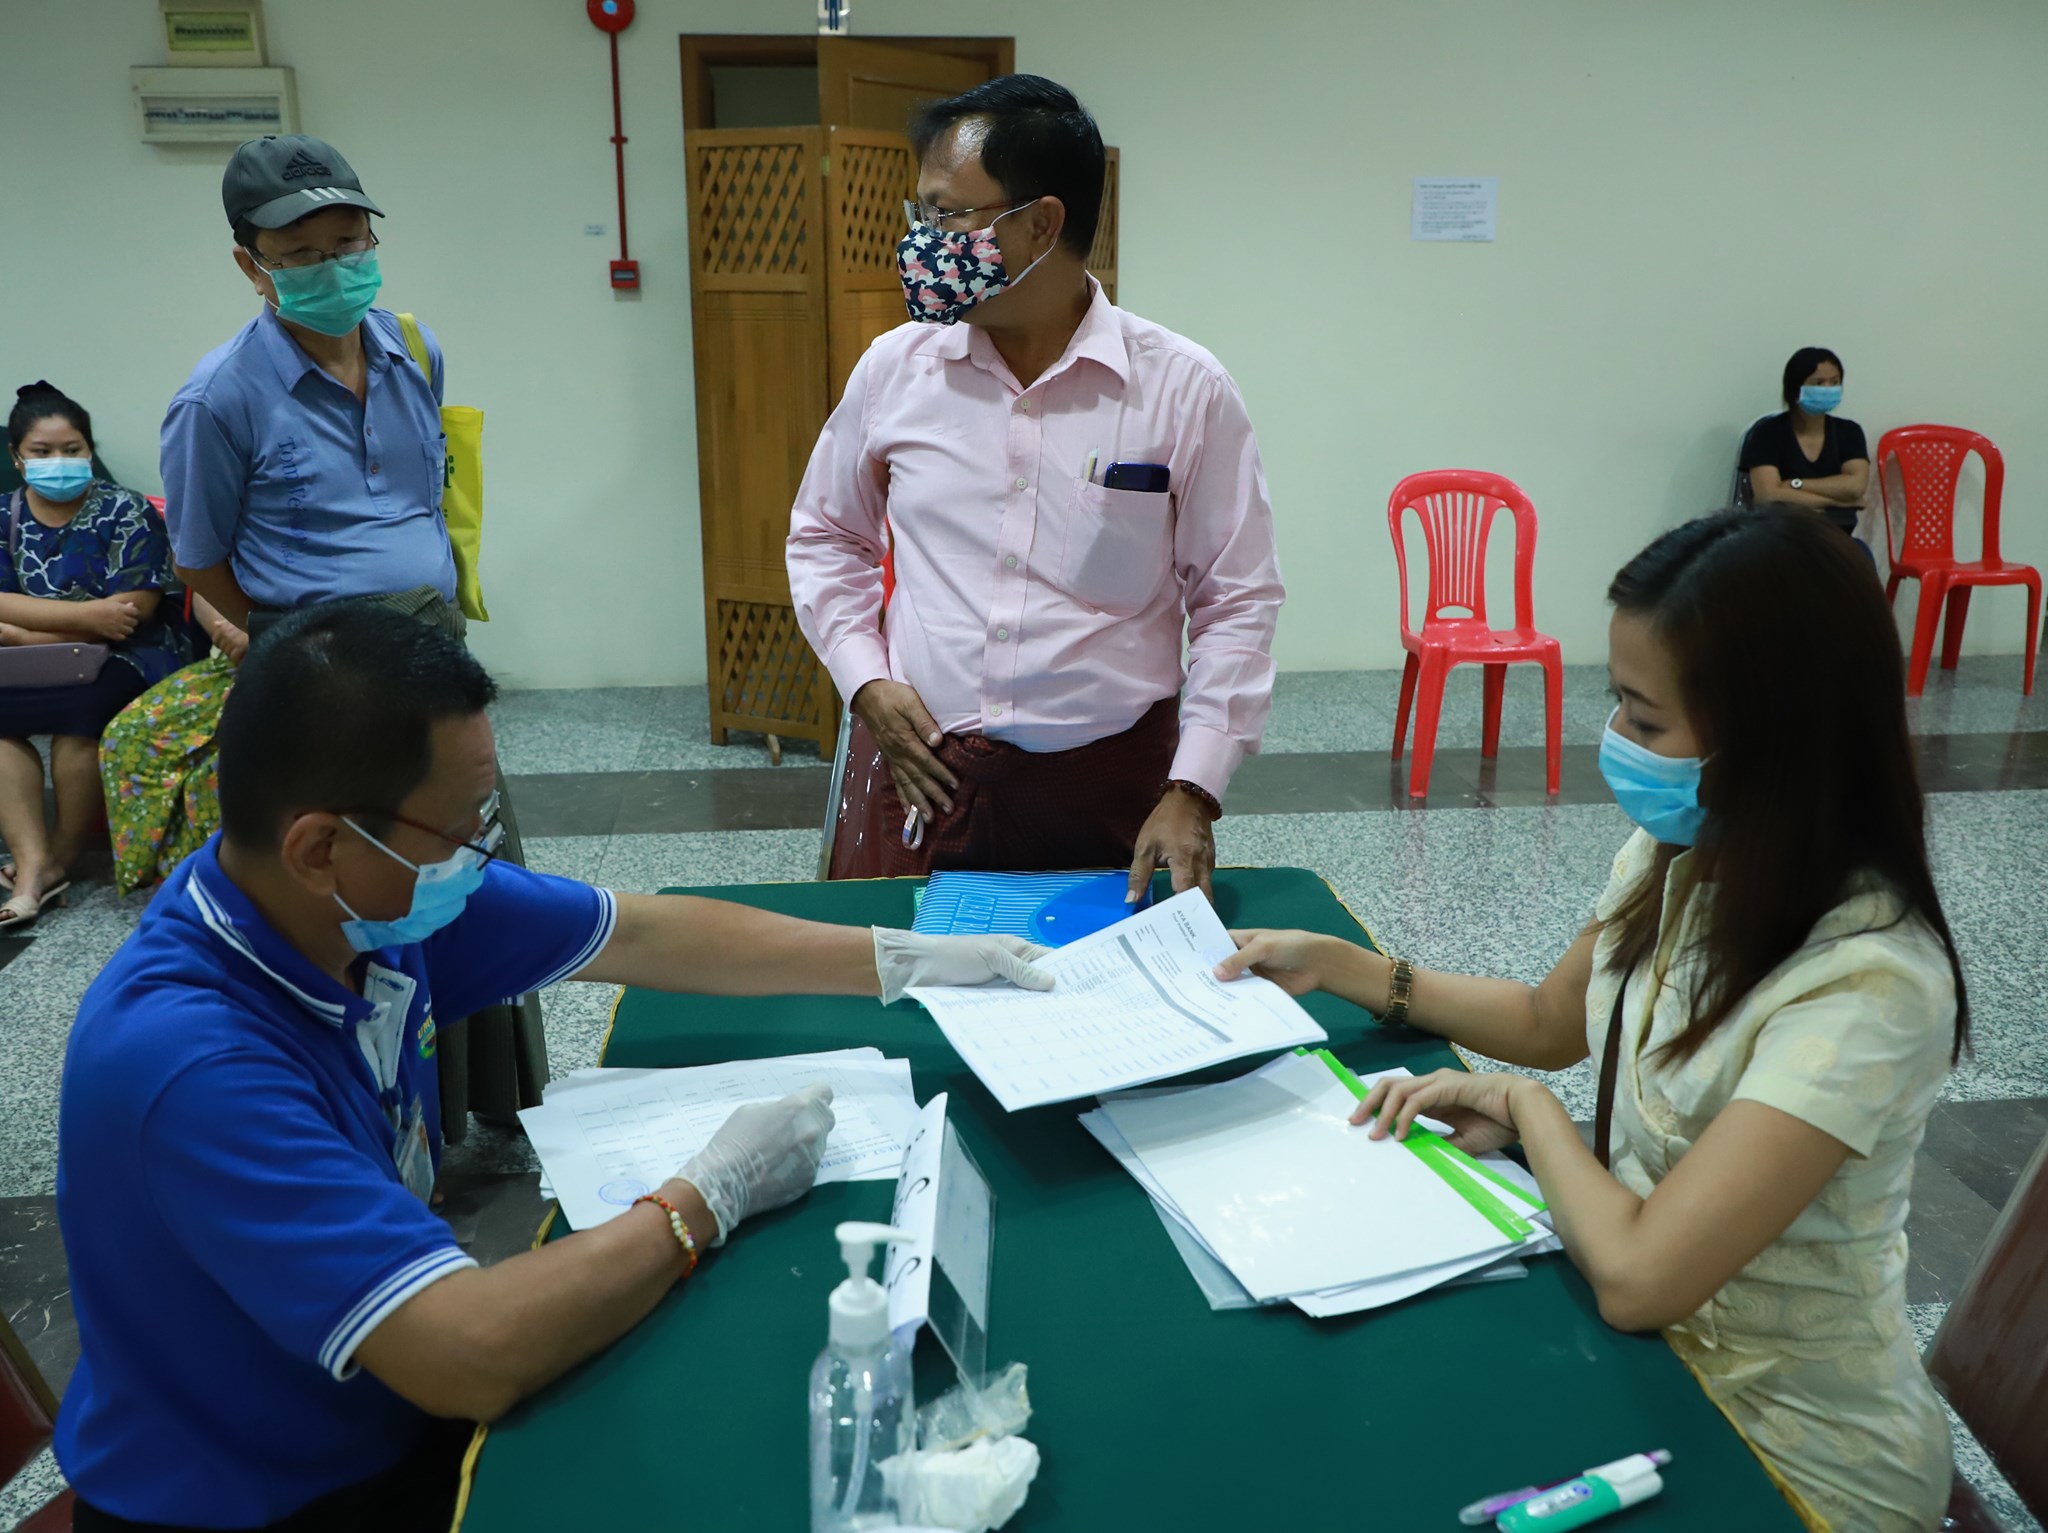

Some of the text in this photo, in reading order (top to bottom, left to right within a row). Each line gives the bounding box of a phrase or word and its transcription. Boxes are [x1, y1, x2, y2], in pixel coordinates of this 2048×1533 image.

[277, 436, 299, 481] Tom
[949, 893, 995, 935] CLEAR BA
[1177, 910, 1196, 938] AYA BANK
